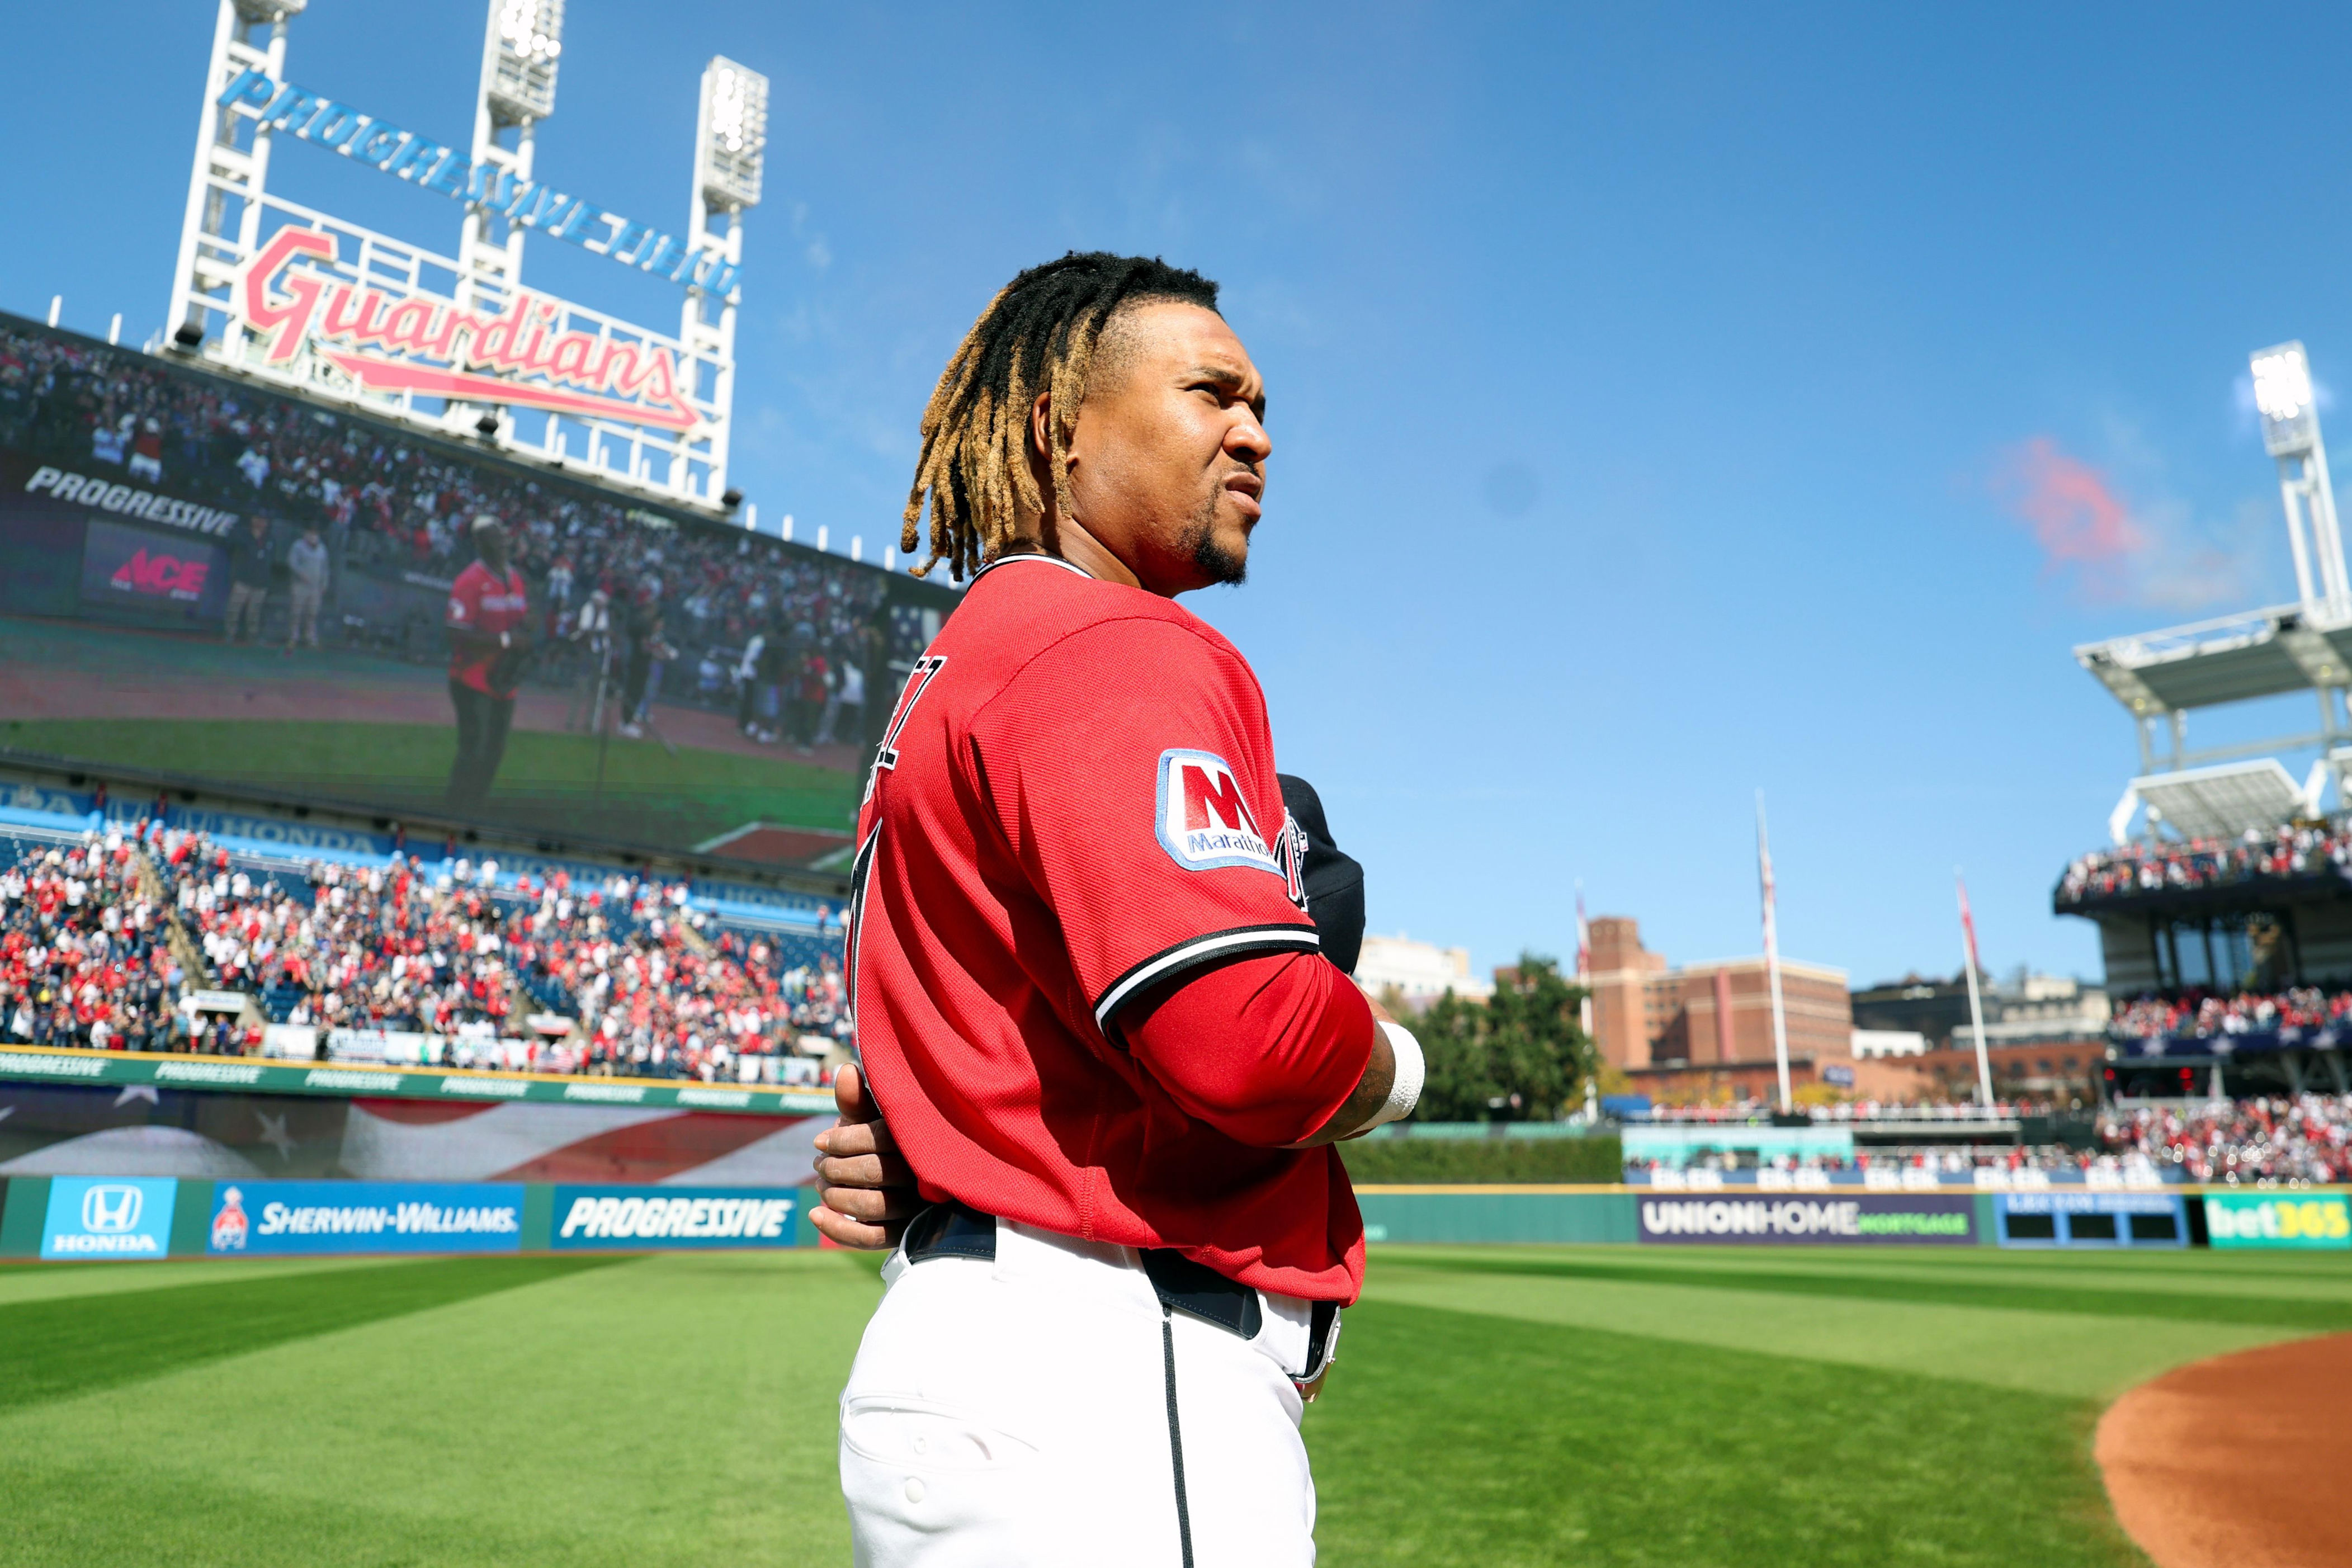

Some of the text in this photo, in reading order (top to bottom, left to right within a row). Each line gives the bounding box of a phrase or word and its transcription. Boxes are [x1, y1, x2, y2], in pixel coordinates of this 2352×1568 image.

[244, 225, 693, 409] Guardians
[25, 465, 239, 537] PROGRESSIVE
[113, 546, 209, 594] ACE
[221, 815, 377, 854] HONDA
[1187, 833, 1272, 859] Maratho
[560, 1197, 792, 1238] PROGRESSIVE
[2205, 1198, 2350, 1239] bet365
[53, 1234, 158, 1252] HONDA
